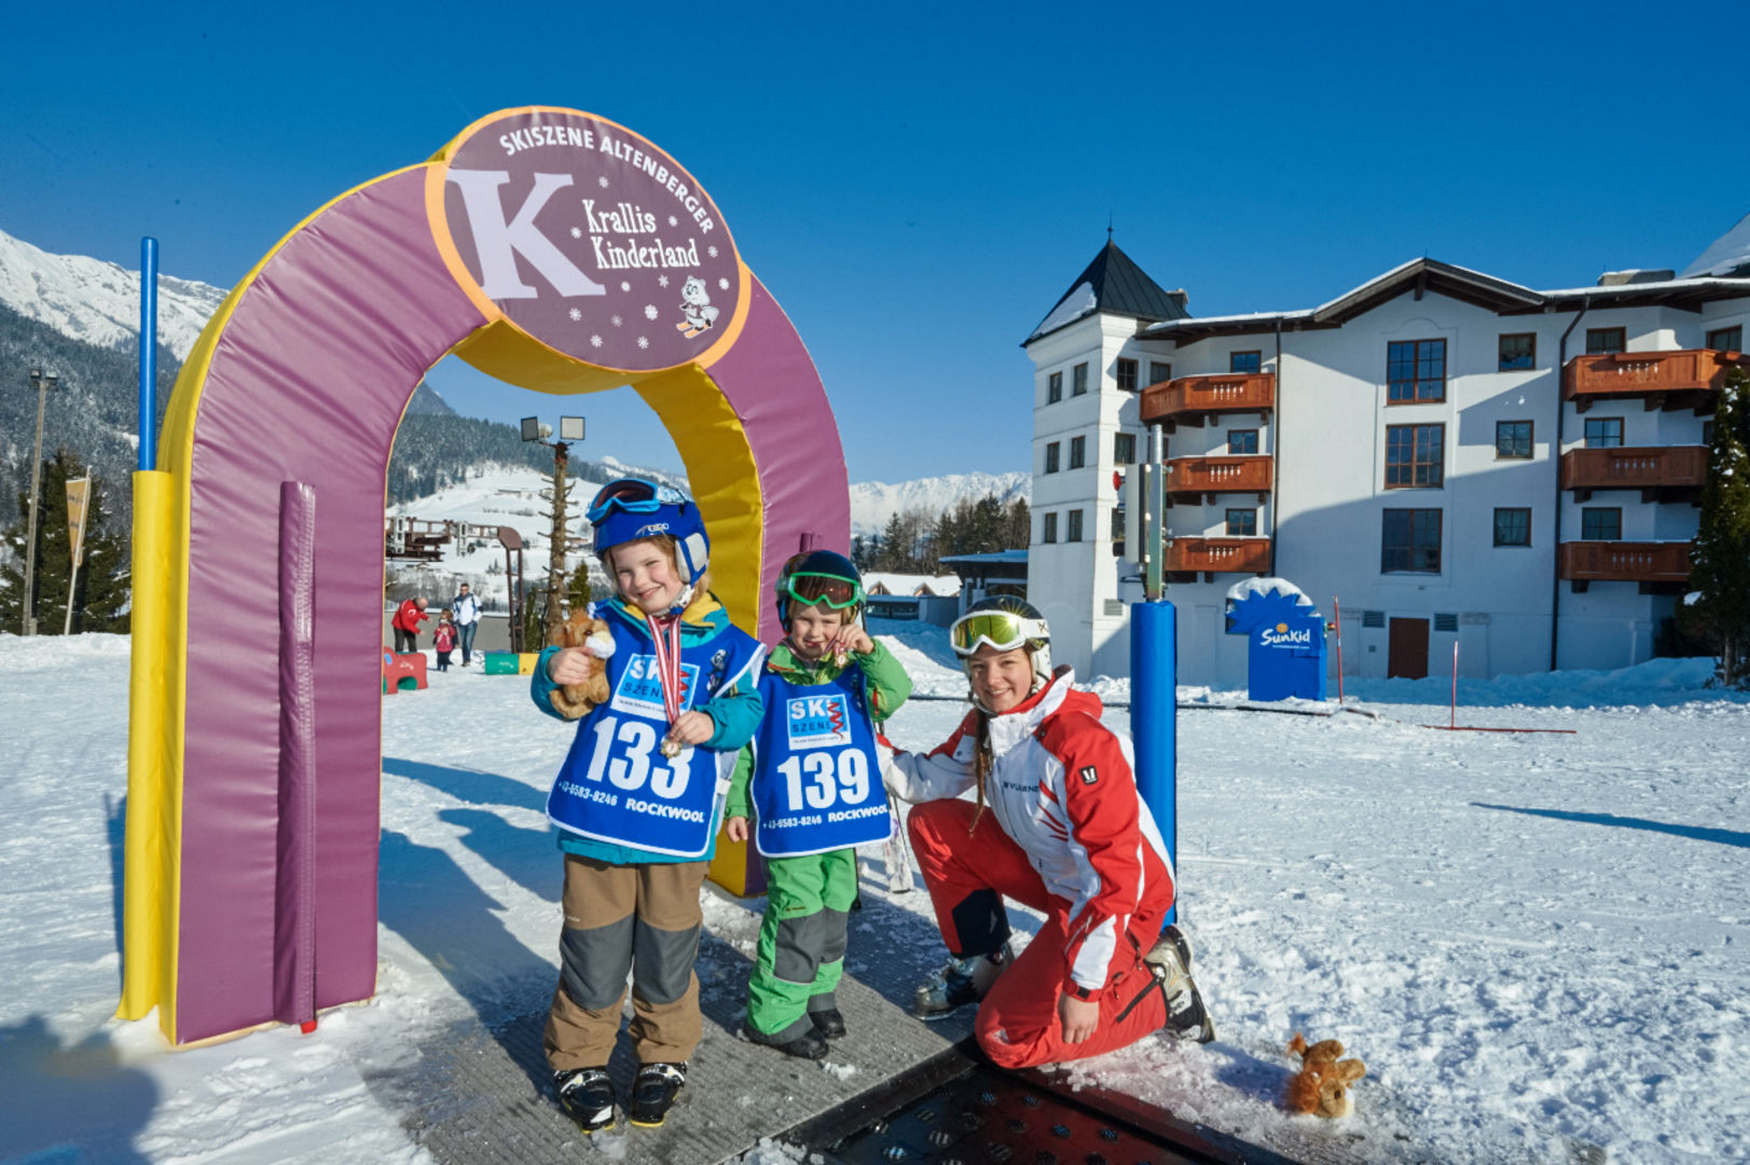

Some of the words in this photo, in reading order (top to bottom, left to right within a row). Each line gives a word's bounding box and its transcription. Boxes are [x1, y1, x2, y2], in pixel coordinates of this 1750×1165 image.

[500, 126, 595, 156] SKISZENE
[600, 136, 714, 234] ALTENBERGER
[582, 199, 656, 234] Krallis
[444, 168, 607, 301] K
[591, 236, 701, 269] Kinderland
[629, 659, 662, 683] SK
[623, 681, 664, 698] SZEN
[586, 716, 695, 799] 133
[777, 748, 870, 811] 139
[625, 798, 704, 823] ROCKWOOL
[828, 803, 888, 822] ROCKWOOL
